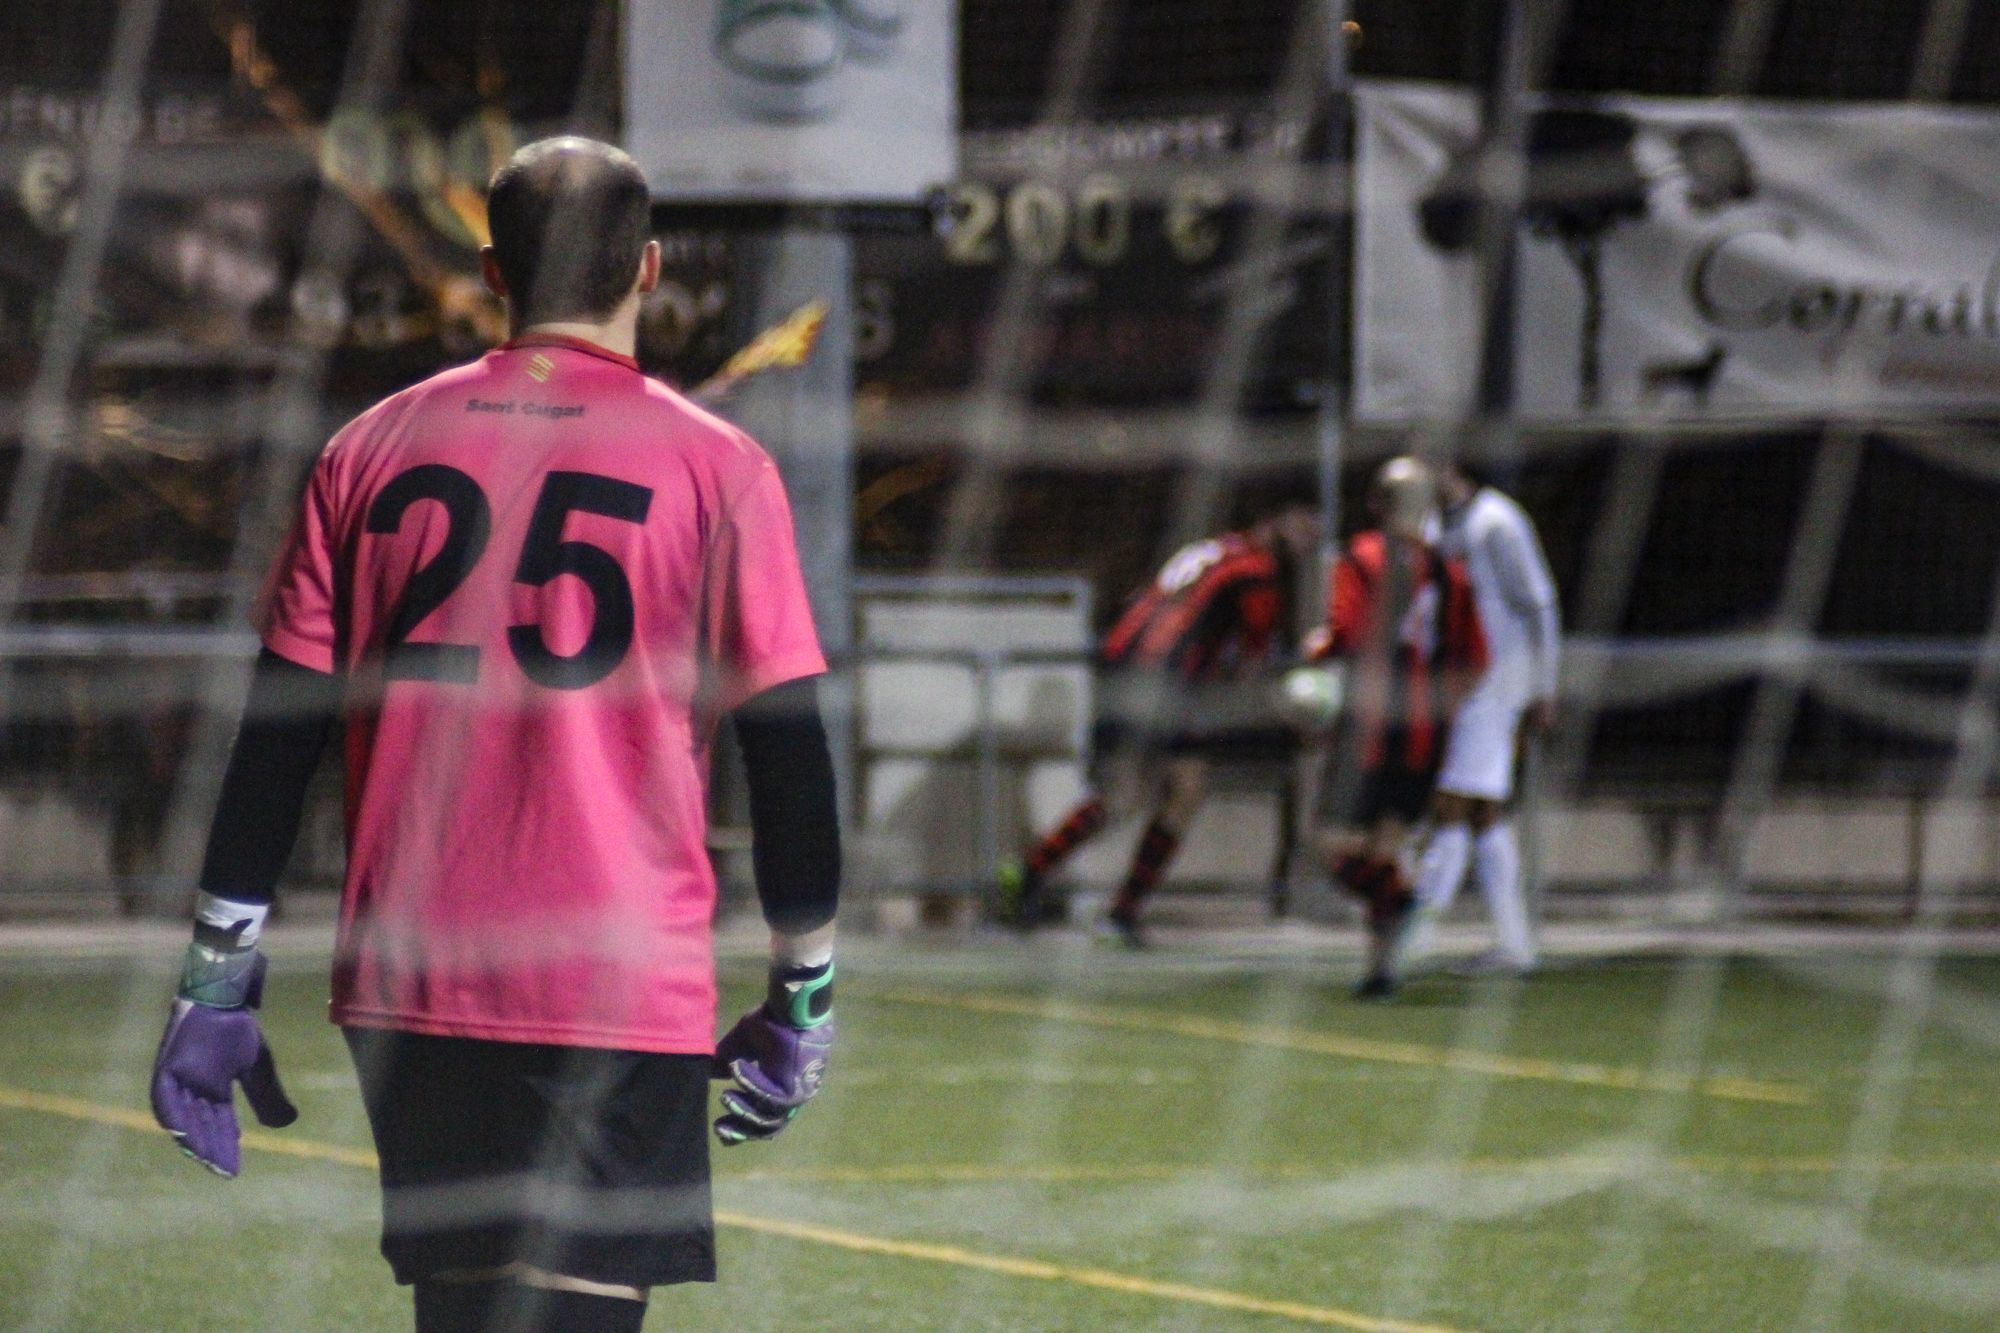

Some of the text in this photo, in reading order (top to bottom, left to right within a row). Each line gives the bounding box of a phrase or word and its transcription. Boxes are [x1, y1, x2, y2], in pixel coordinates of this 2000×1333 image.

[940, 178, 1133, 267] 200
[465, 399, 586, 420] Sant Cugat
[366, 464, 654, 690] 25
